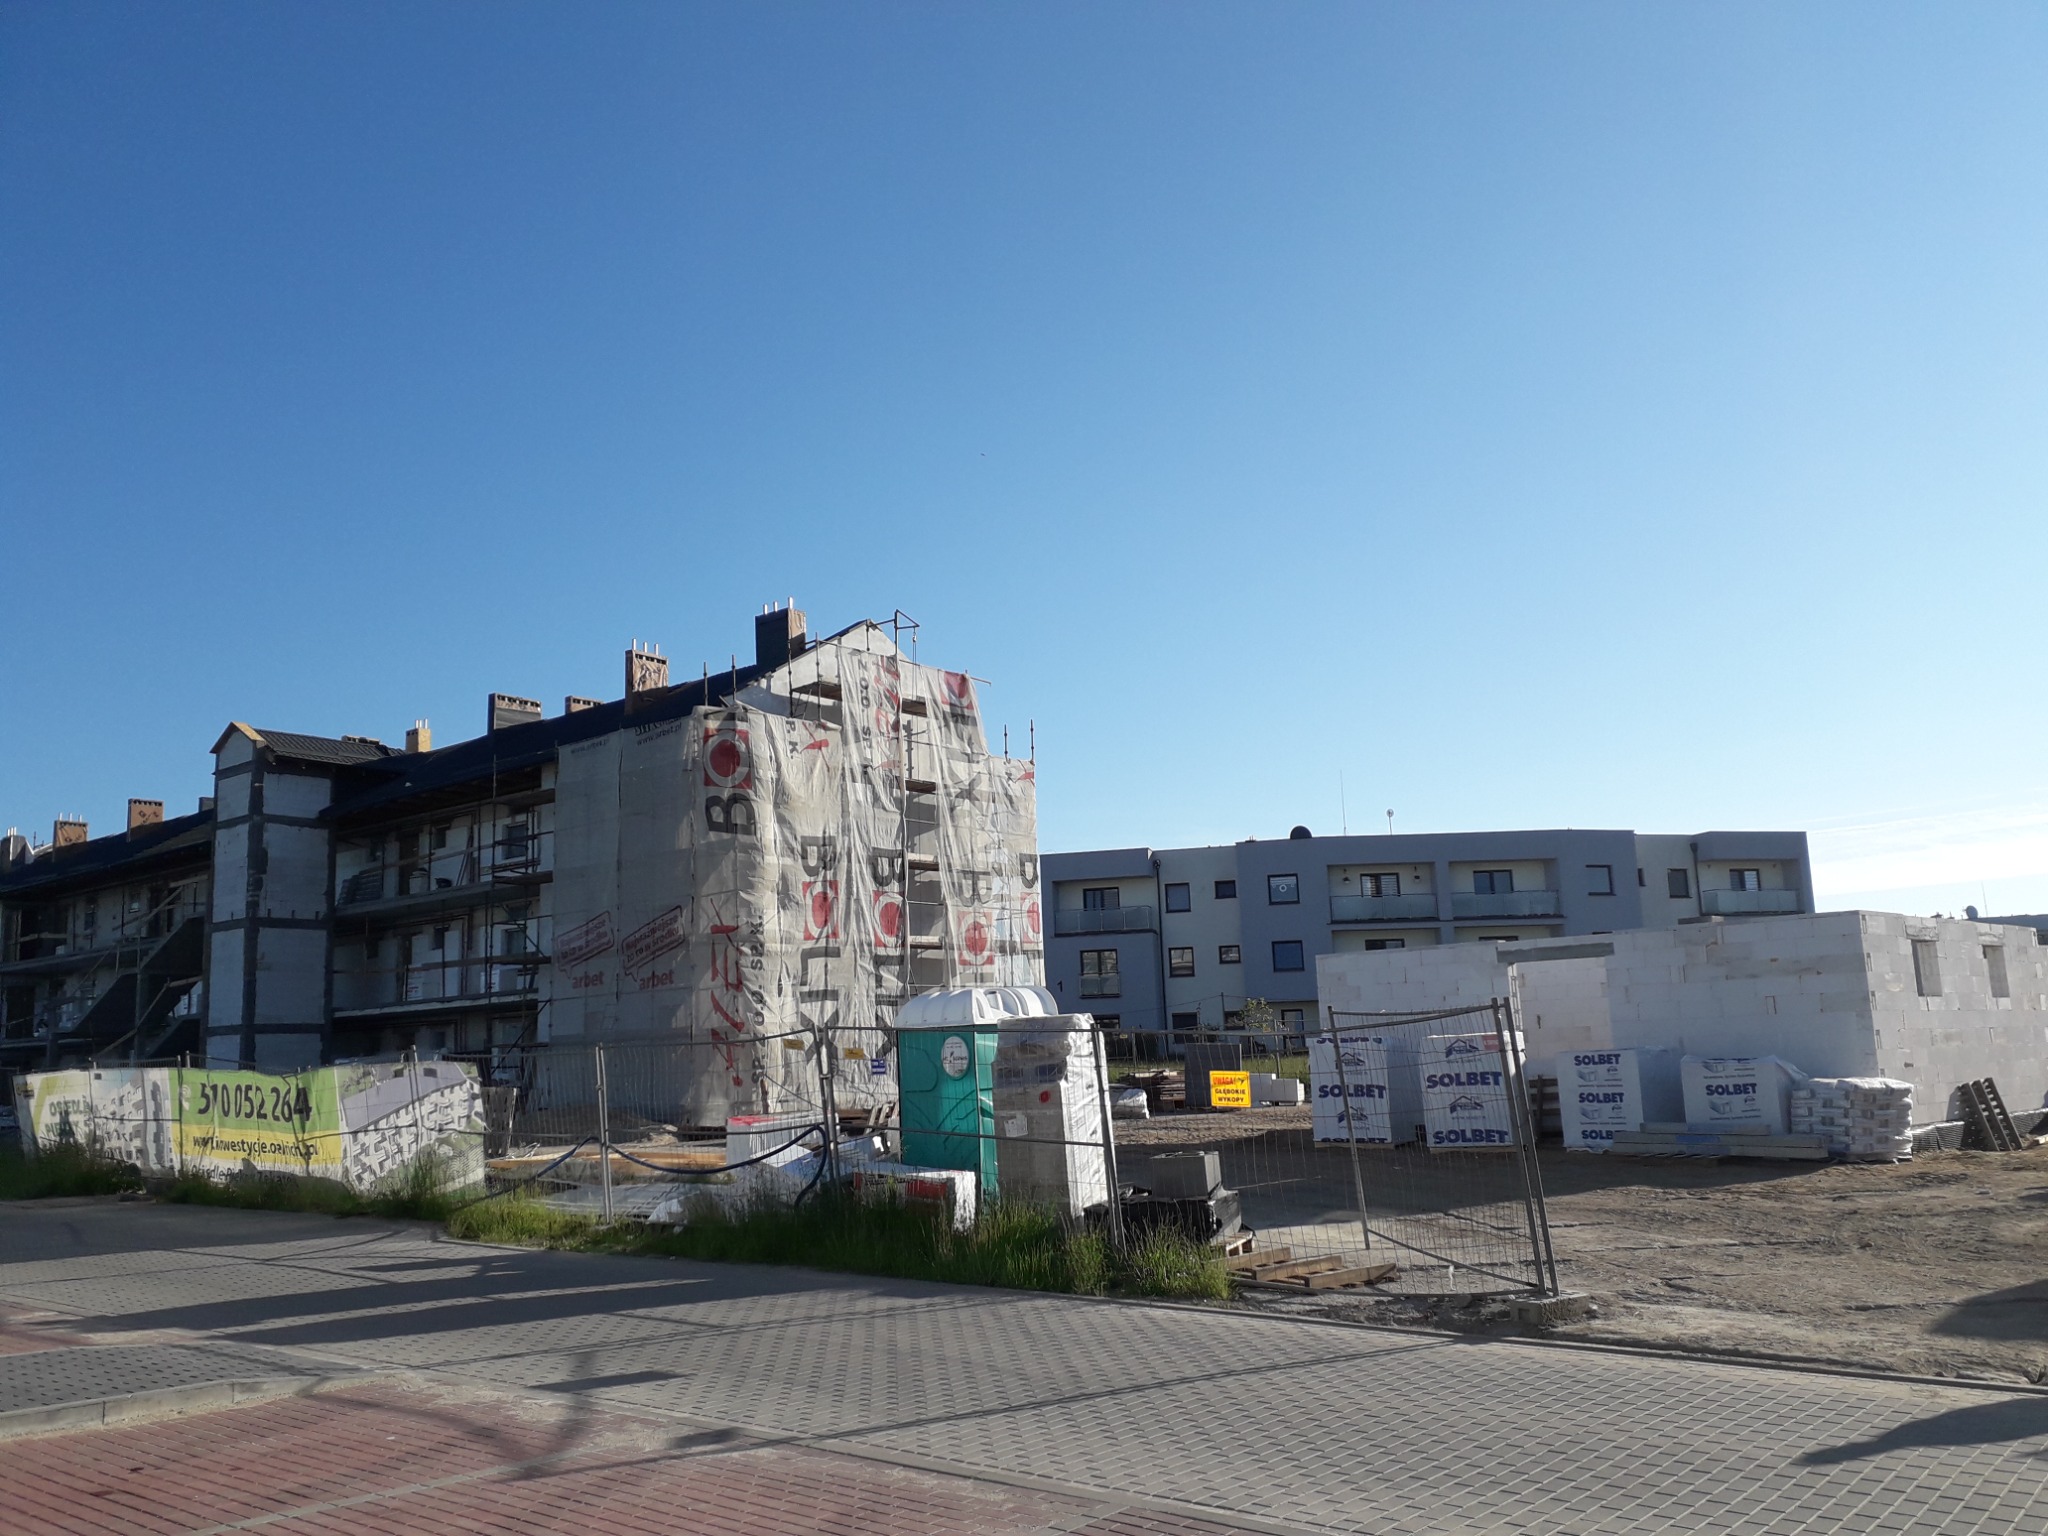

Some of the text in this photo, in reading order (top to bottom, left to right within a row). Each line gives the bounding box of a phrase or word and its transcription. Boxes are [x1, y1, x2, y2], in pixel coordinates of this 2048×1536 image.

[572, 971, 604, 989] arbet
[639, 969, 674, 990] arbet
[1574, 1053, 1621, 1066] SOLBET
[1426, 1071, 1502, 1089] SOLBET
[1319, 1084, 1386, 1099] SOLBET
[1705, 1082, 1757, 1096] SOLBET
[270, 1086, 312, 1123] 264
[1579, 1092, 1625, 1104] SOLBET
[1433, 1128, 1509, 1145] SOLBET
[1581, 1129, 1614, 1140] SOLB
